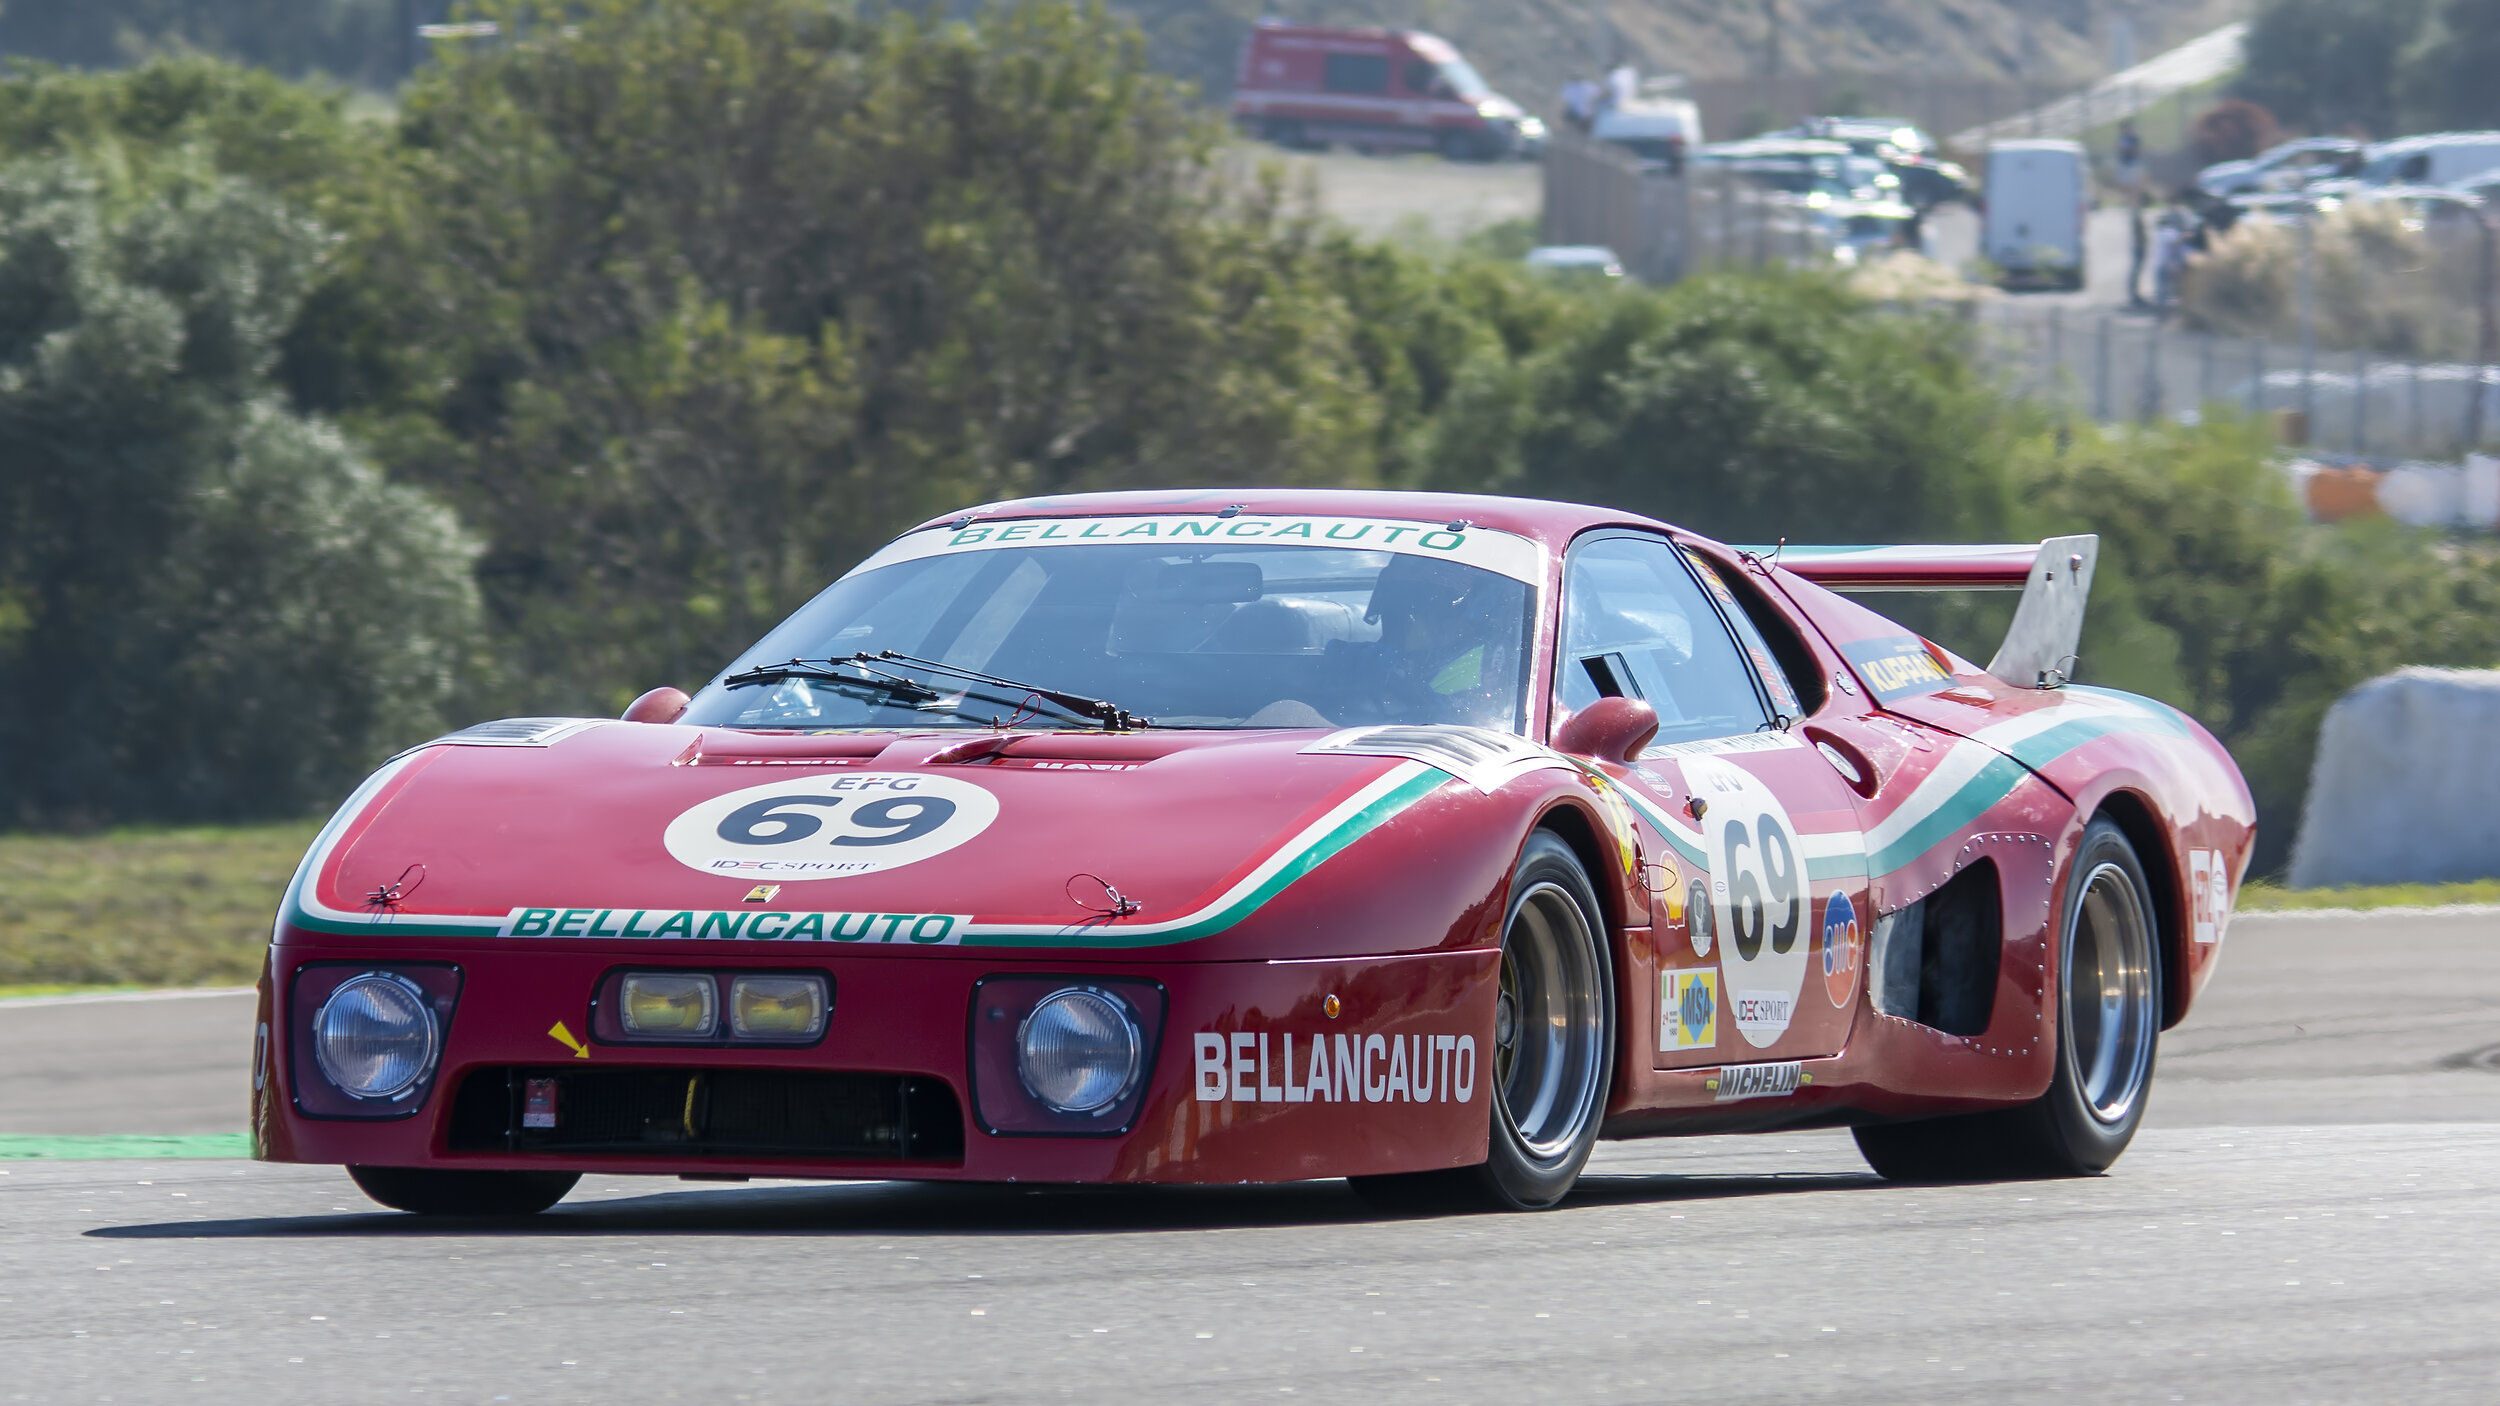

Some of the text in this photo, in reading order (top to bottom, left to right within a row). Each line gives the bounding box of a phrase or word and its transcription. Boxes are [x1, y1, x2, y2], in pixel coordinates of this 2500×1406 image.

[948, 520, 1468, 551] BELLANCAUTO
[830, 777, 920, 791] EFG
[716, 794, 956, 847] 69
[711, 860, 876, 870] IDEC SPORT
[1724, 813, 1800, 962] 69
[509, 908, 958, 944] BELLANCAUTO
[1681, 986, 1711, 1026] IMSA
[1760, 1000, 1789, 1021] SPORT
[1194, 1032, 1476, 1103] BELLANCAUTO
[1717, 1064, 1799, 1097] MICHELIN
